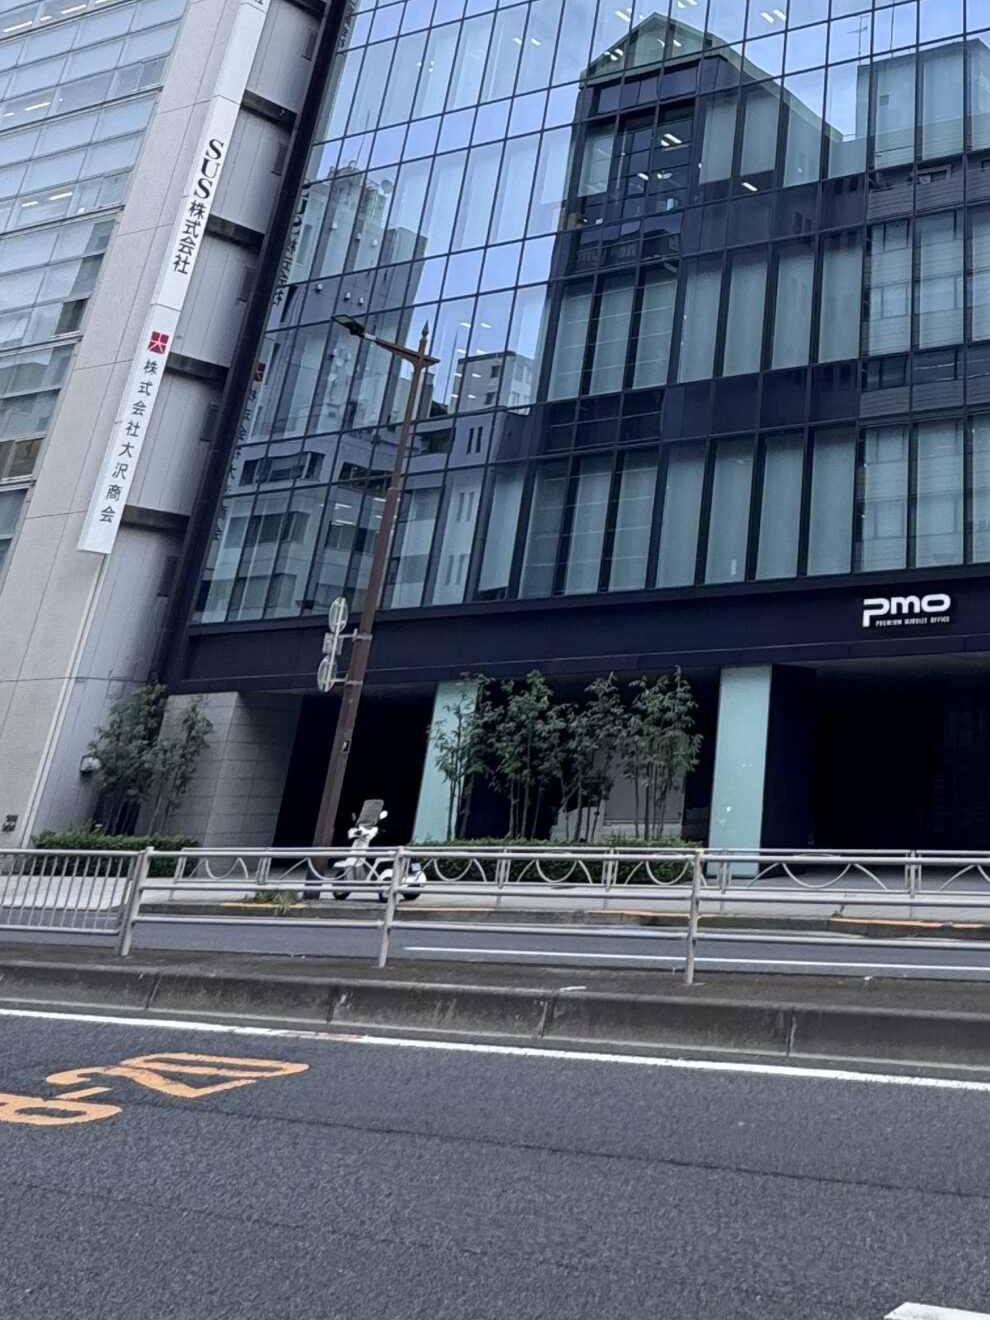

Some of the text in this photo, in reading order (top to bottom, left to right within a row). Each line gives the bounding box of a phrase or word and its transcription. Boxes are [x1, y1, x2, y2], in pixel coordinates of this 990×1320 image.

[99, 358, 160, 524] 株式会社大沢商会
